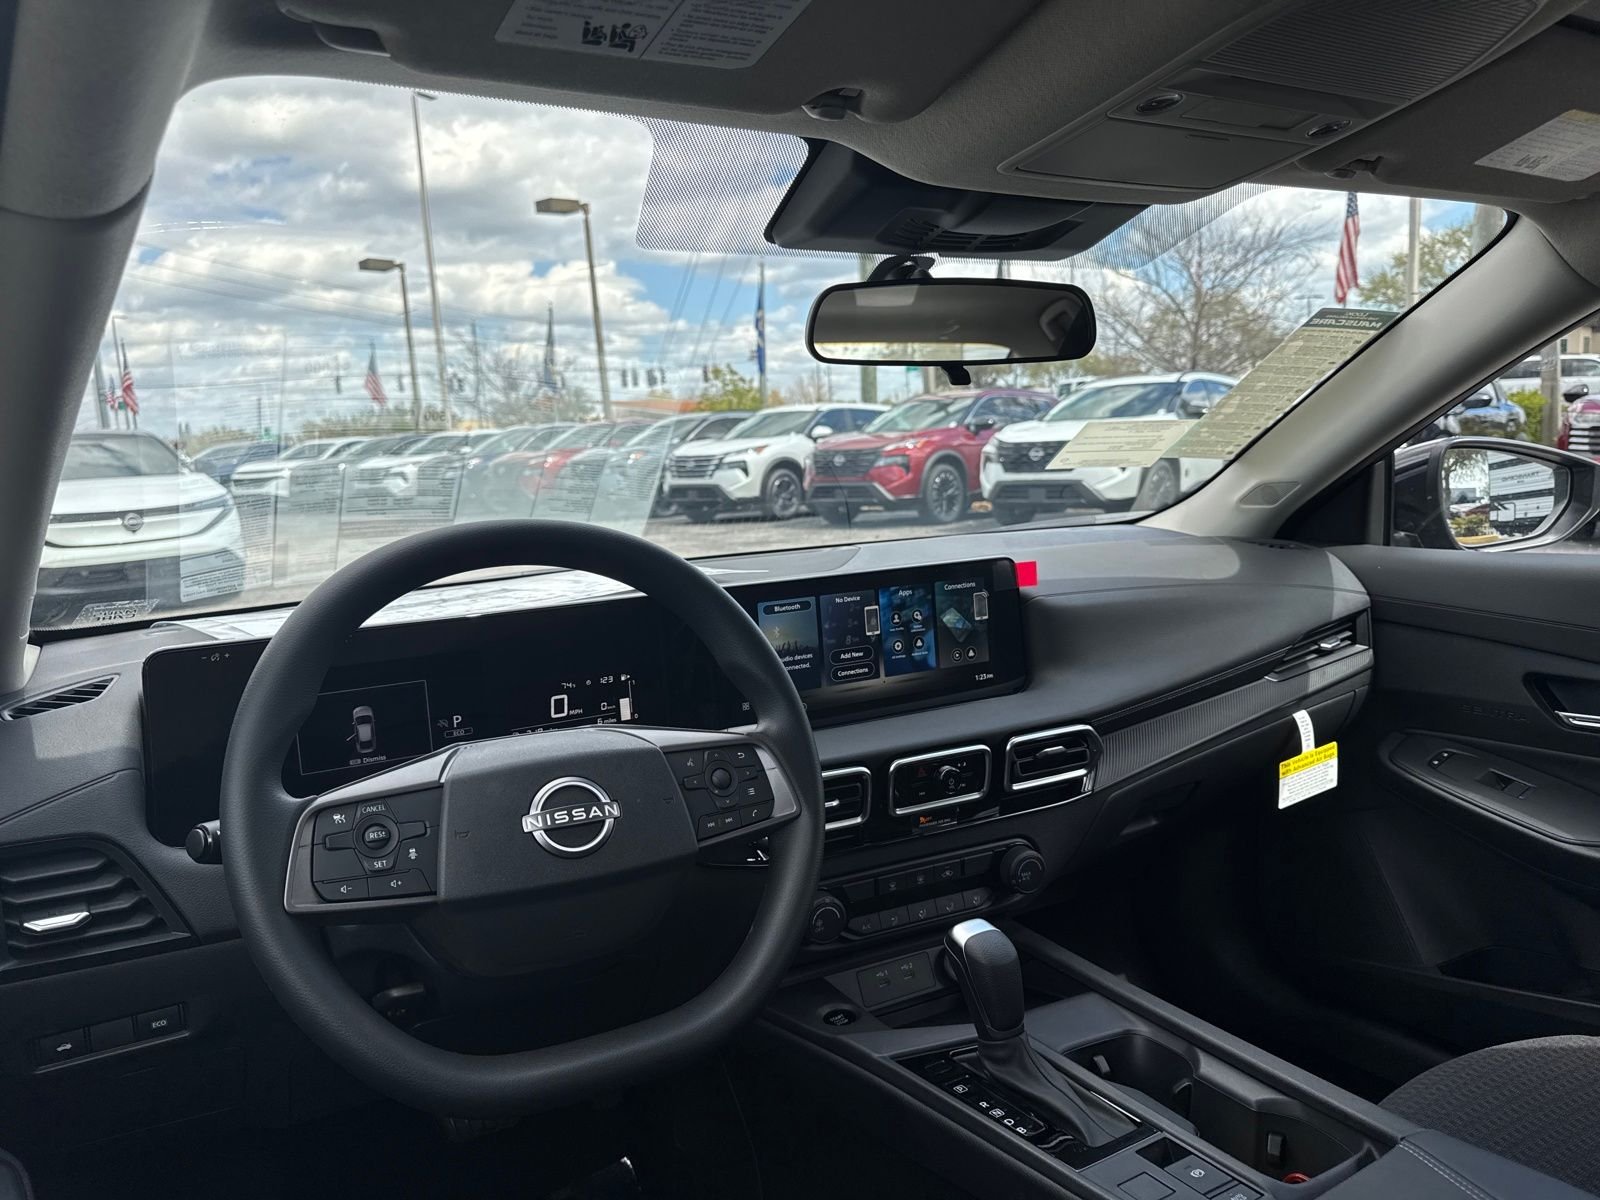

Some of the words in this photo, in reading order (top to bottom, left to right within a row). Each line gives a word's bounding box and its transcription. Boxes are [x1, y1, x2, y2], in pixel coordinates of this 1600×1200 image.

[944, 581, 976, 590] Connections
[898, 588, 912, 597] Apps
[774, 603, 801, 612] Bluetooth
[840, 652, 851, 660] Add
[851, 650, 864, 658] New
[785, 662, 810, 671] onnected.
[837, 666, 869, 677] Connections
[551, 694, 568, 718] 0
[453, 715, 462, 728] P
[363, 755, 387, 764] Dismiss
[362, 804, 386, 814] CANCEL
[524, 803, 620, 831] NISSAN
[373, 860, 387, 868] SET
[152, 1019, 167, 1029] ECO
[1003, 1118, 1015, 1126] D
[1016, 1126, 1027, 1134] B
